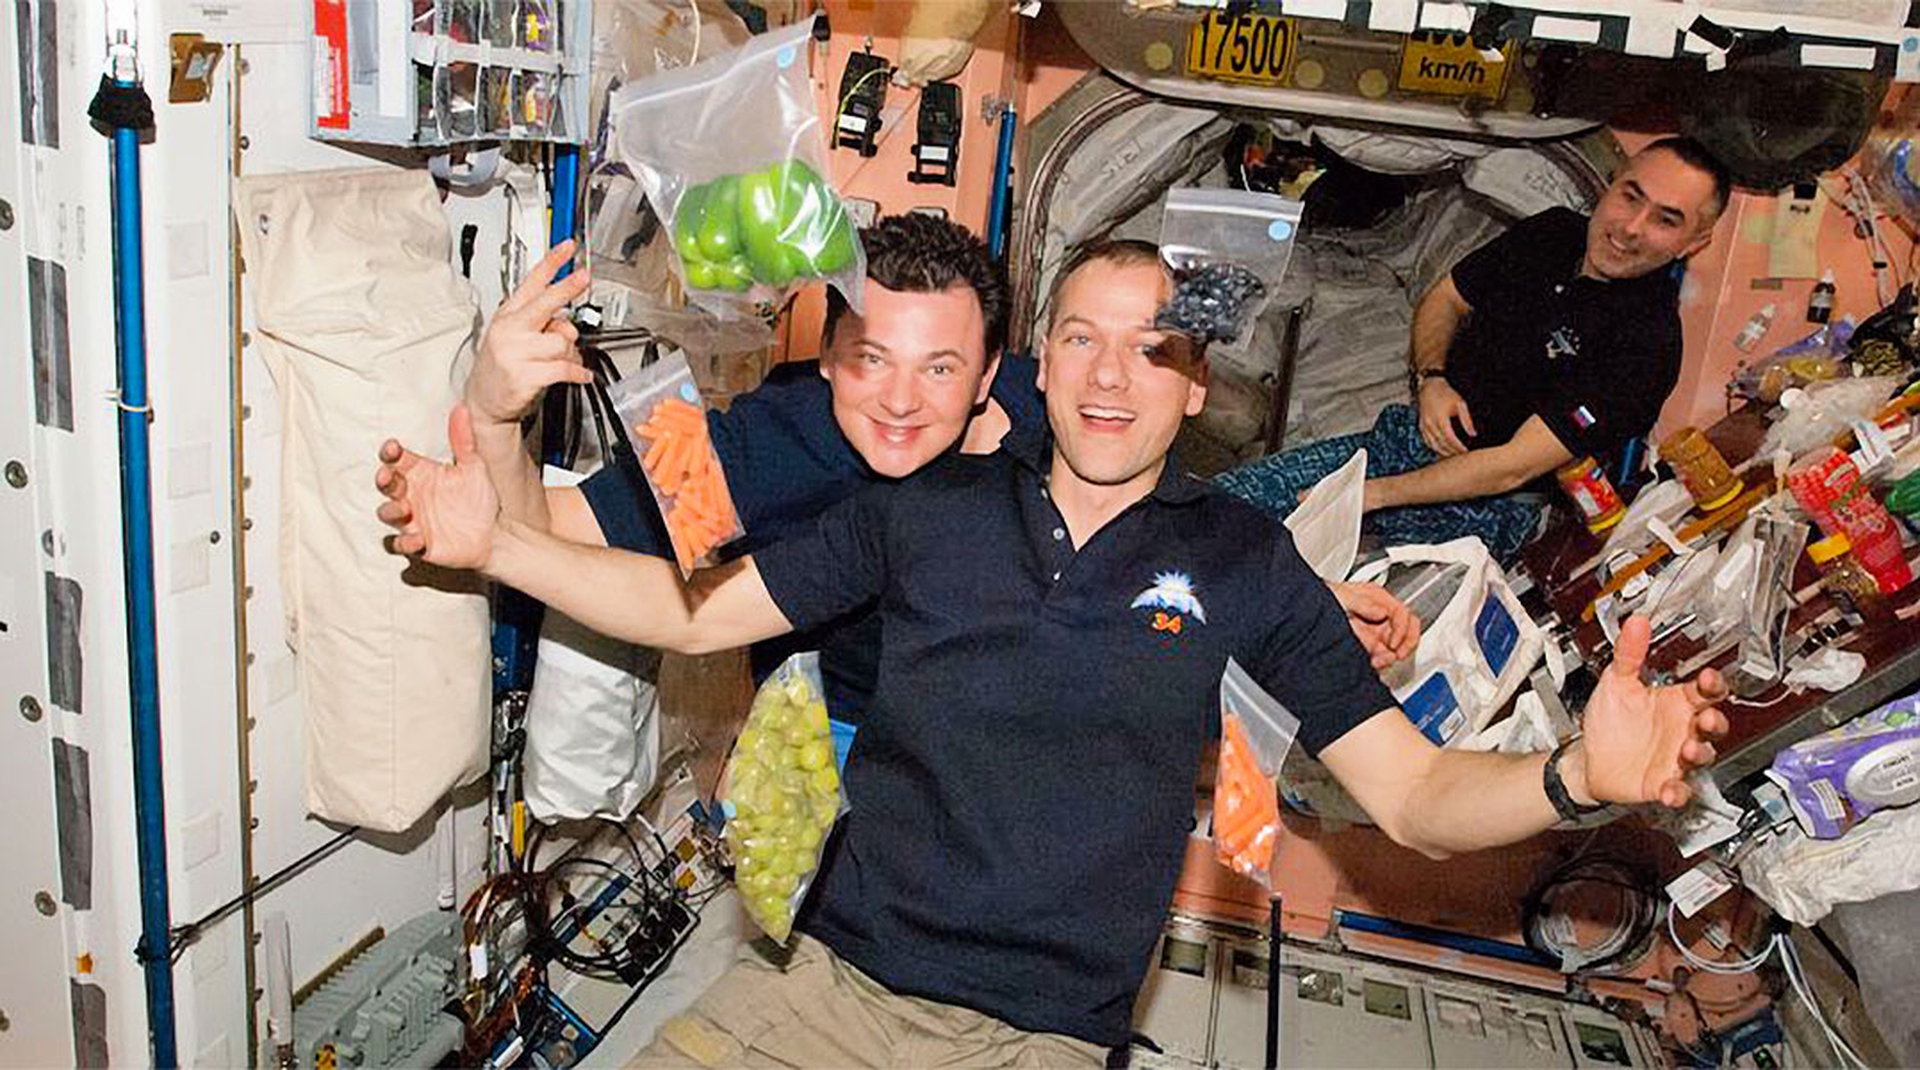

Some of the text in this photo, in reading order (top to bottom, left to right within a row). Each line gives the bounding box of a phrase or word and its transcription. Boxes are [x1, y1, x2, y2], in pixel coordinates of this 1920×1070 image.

[1199, 12, 1289, 77] 17500
[1418, 56, 1485, 83] km/h
[1151, 611, 1181, 635] 34
